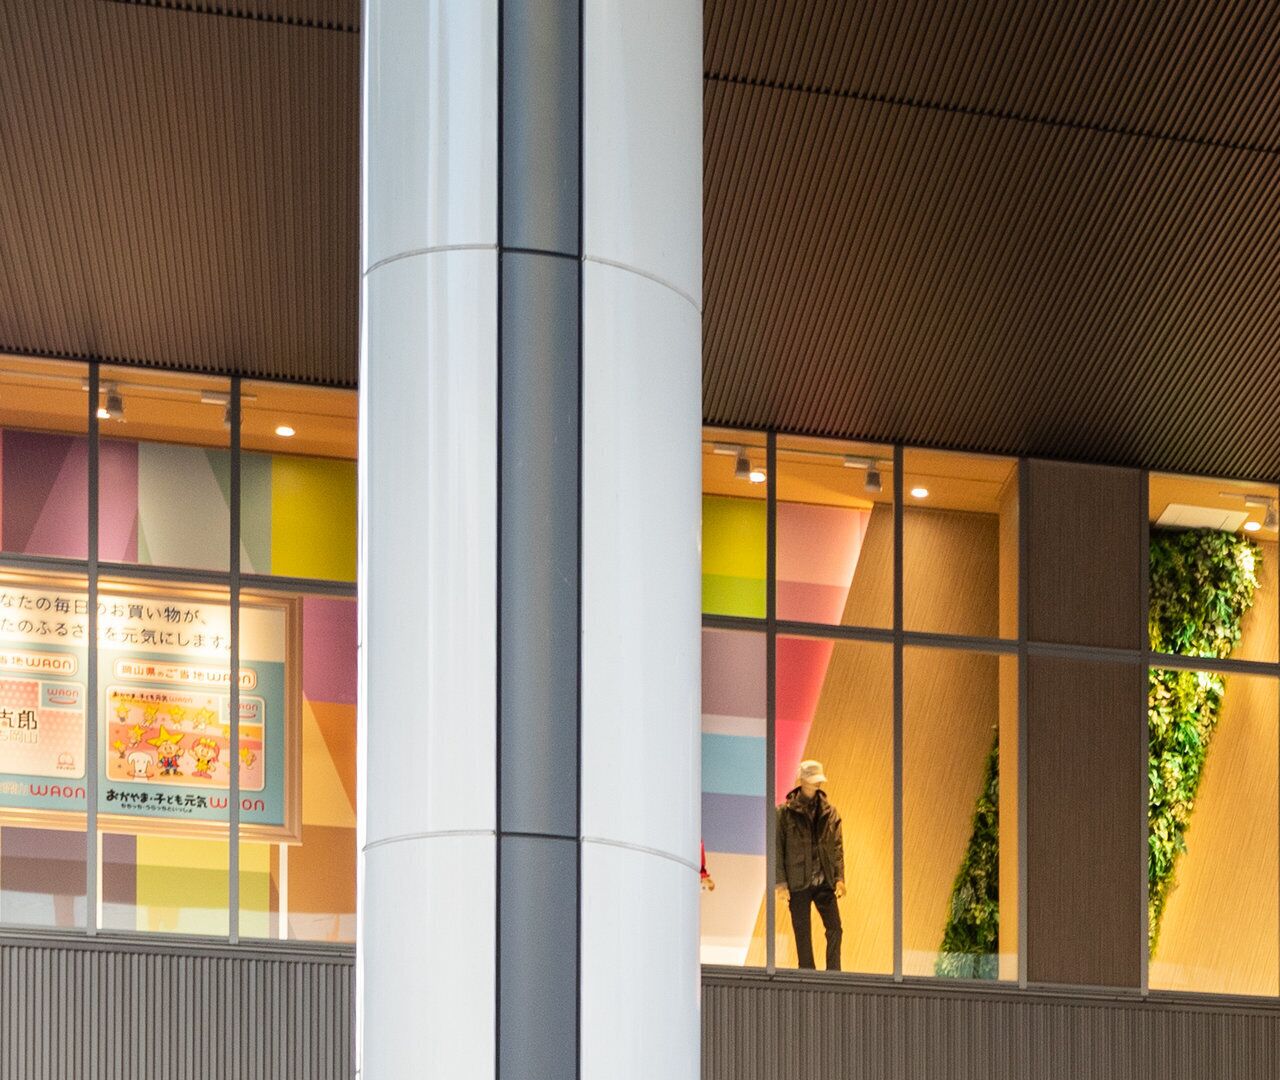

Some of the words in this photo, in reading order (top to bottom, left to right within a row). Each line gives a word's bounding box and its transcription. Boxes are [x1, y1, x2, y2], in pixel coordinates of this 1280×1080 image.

[1, 617, 232, 650] たのふるさを元気にします。
[106, 788, 266, 813] おかやま・子ども元気WON
